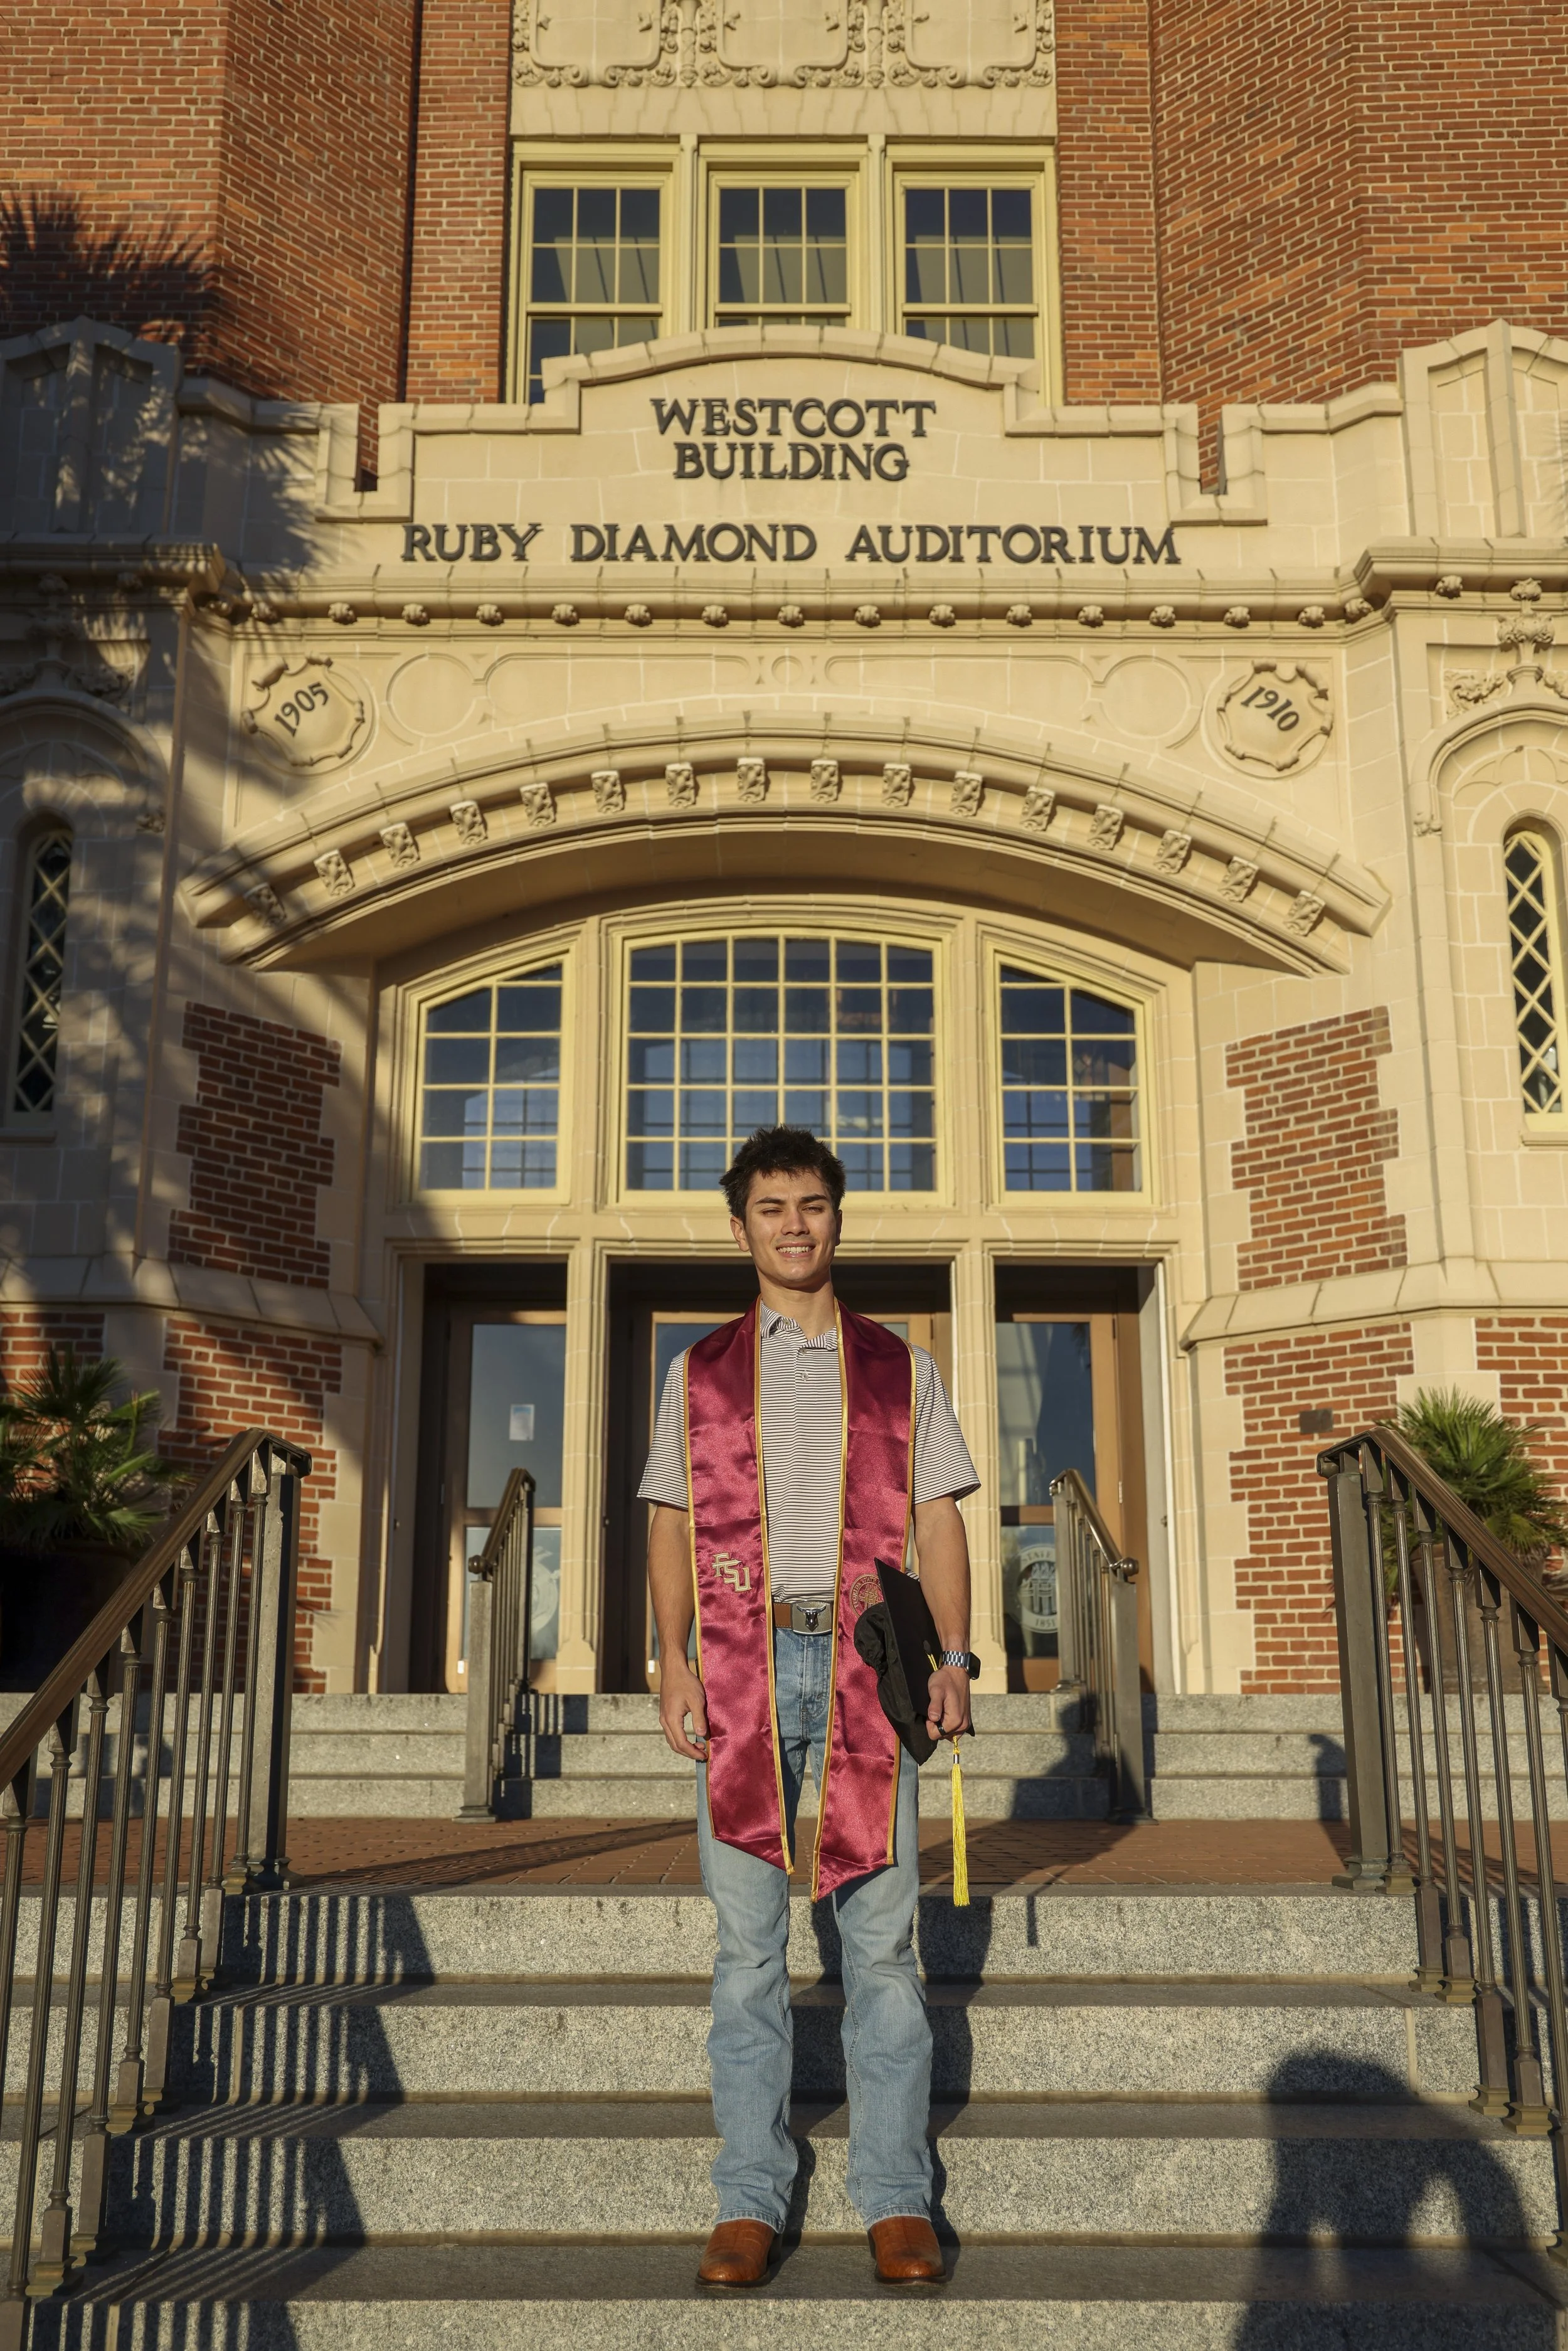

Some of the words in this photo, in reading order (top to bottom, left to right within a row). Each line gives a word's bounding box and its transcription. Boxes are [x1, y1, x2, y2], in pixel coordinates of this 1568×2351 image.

[650, 398, 936, 438] WESTCOTT
[673, 442, 909, 481] BUILDING
[401, 523, 541, 562] RUBY
[570, 523, 817, 563] DIAMOND
[845, 525, 1182, 565] AUDITORIUM
[274, 682, 329, 737] 1905
[1241, 686, 1300, 732] 1910
[711, 1552, 752, 1592] FSU
[852, 1583, 862, 1608] FLORIDA
[1035, 1618, 1056, 1628] 1851
